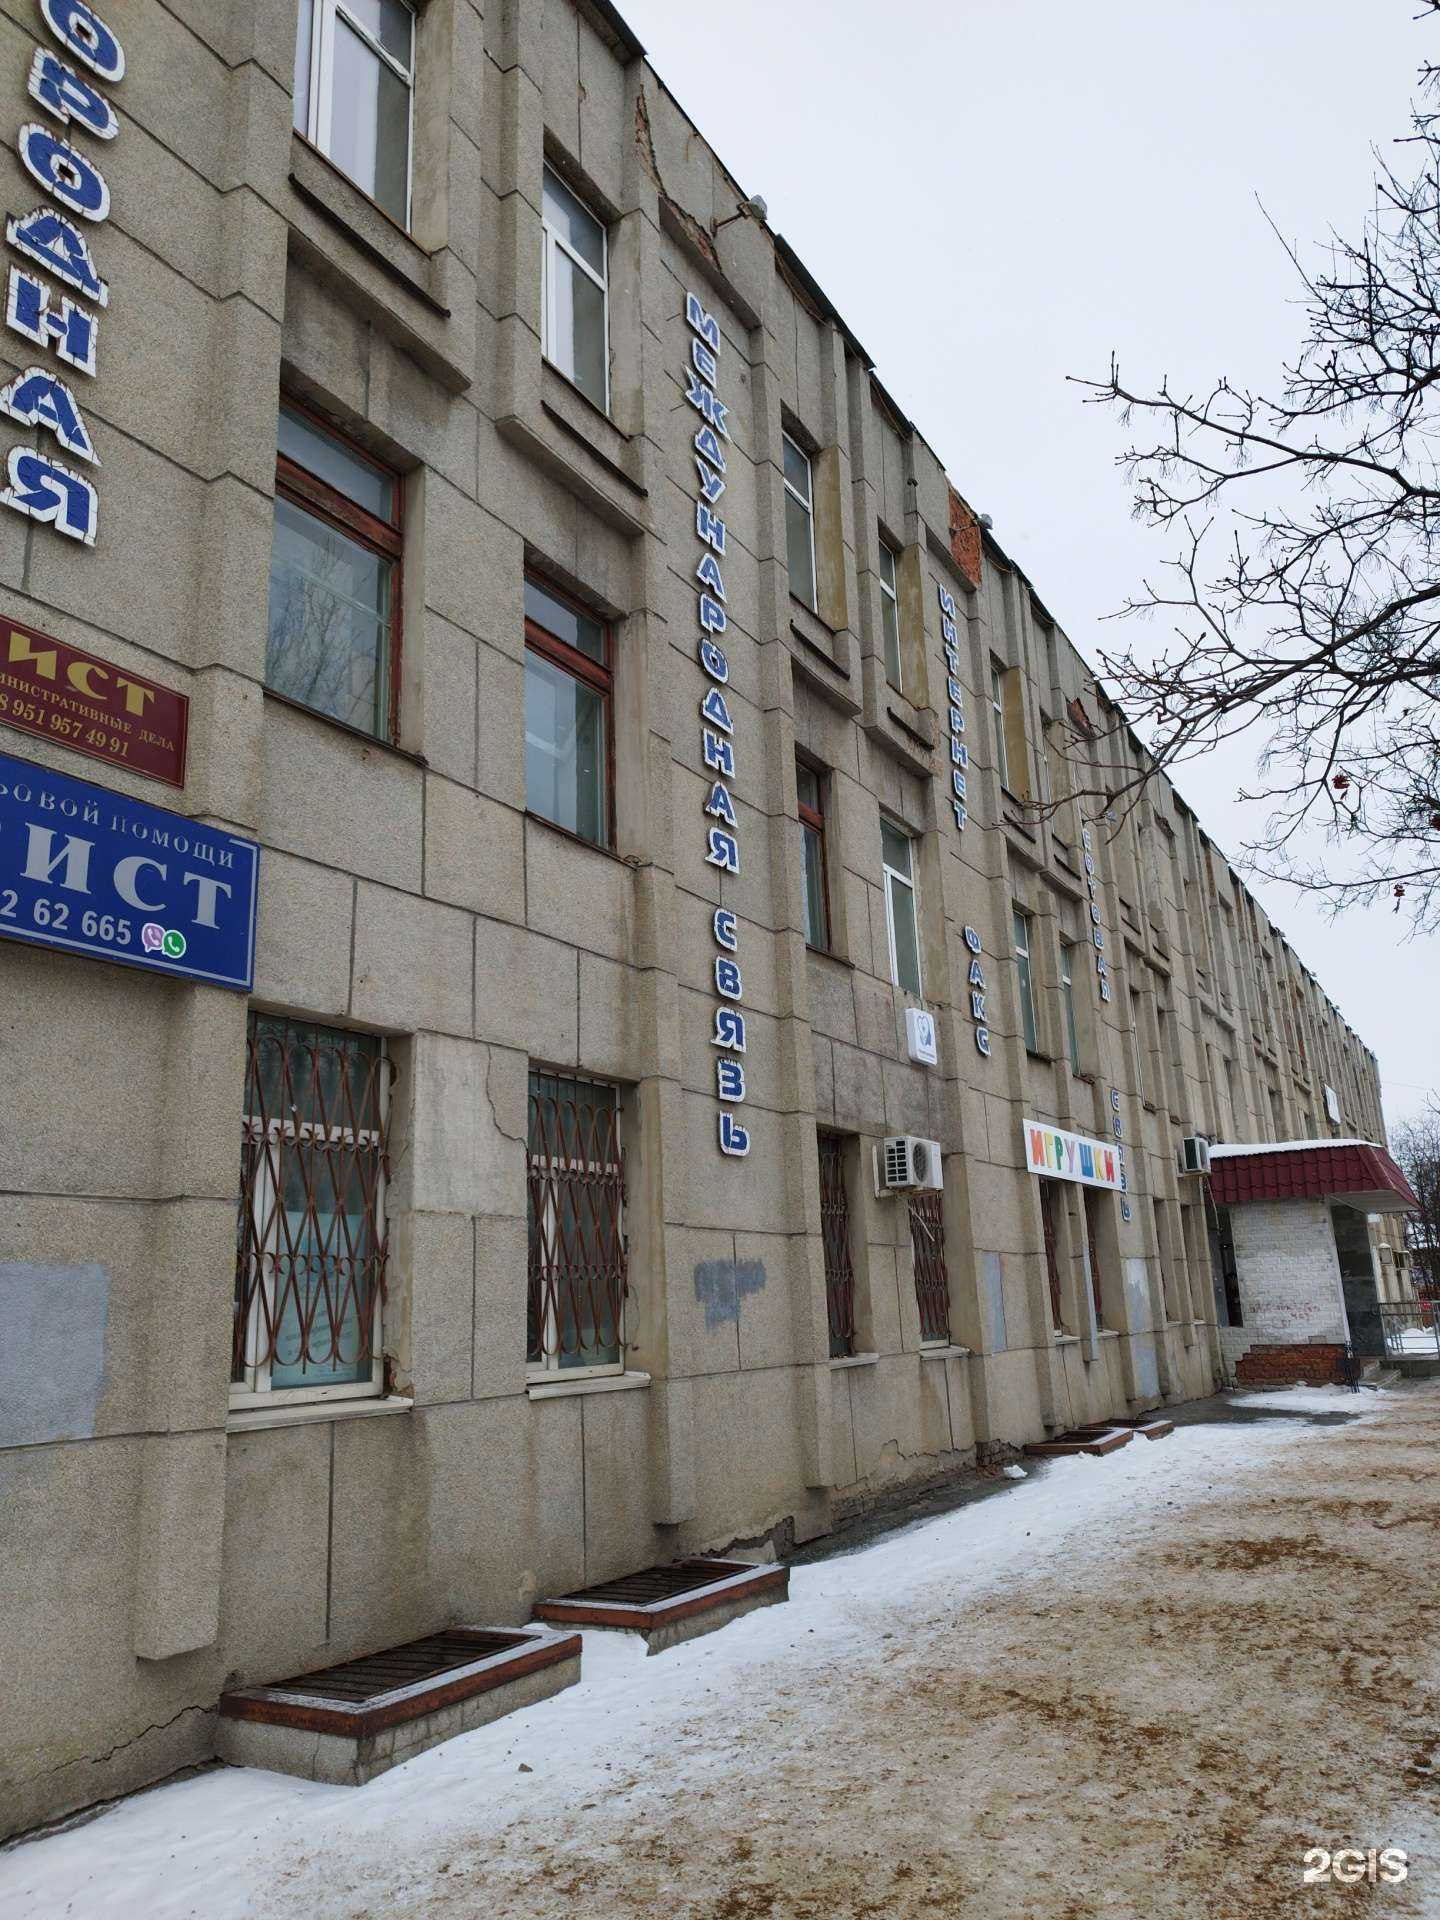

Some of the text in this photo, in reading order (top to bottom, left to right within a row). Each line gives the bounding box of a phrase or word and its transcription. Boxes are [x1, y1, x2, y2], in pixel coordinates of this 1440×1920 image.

[9, 631, 155, 717] ИСТ
[12, 700, 45, 726] 951
[51, 714, 83, 739] 957
[85, 729, 107, 748] 49
[109, 738, 129, 757] 91
[138, 729, 175, 751] ДЕЛА
[682, 291, 750, 1157] МЕЖДУНАРОДНАЯ СВЯЗЬ
[111, 815, 235, 869] ПОМОЩИ
[939, 583, 991, 1057] ИНТЕРНЕТ ФАКС
[33, 898, 70, 931] 62
[82, 910, 132, 945] 665
[1029, 1128, 1116, 1183] ИГРУШКИ
